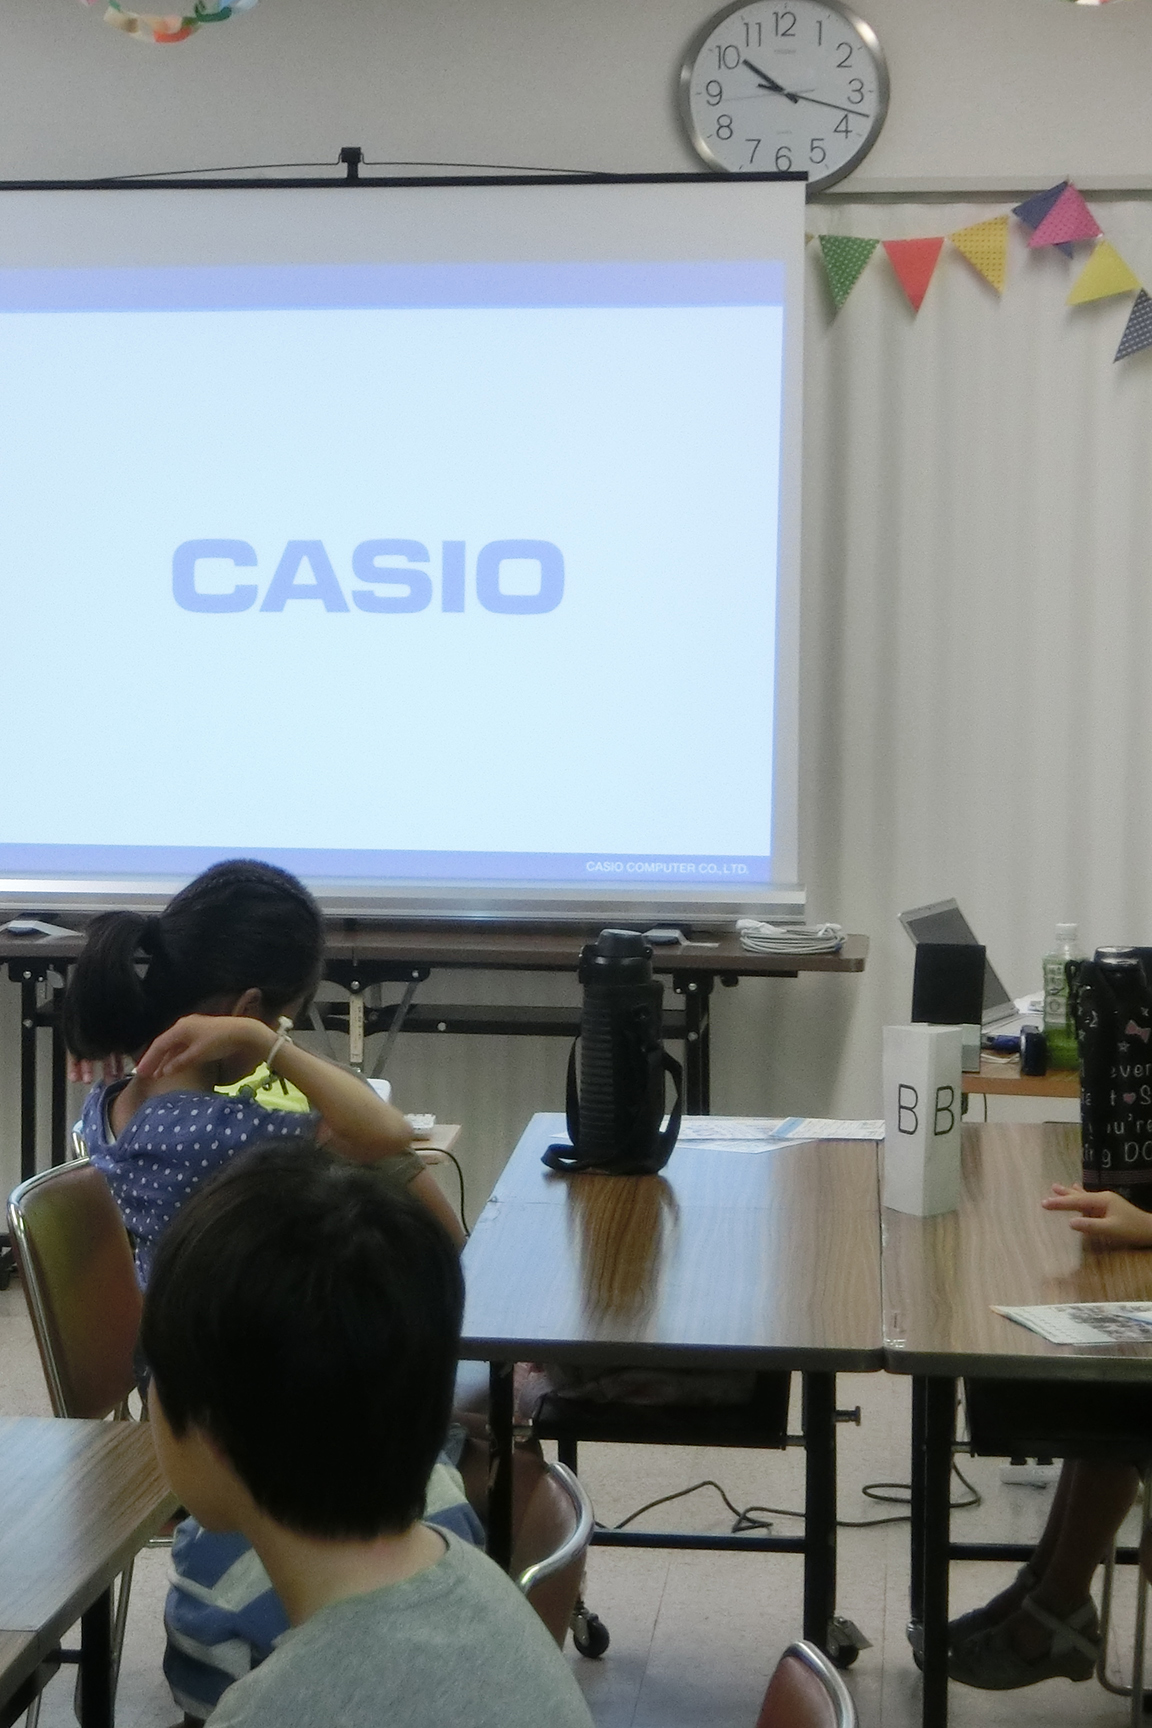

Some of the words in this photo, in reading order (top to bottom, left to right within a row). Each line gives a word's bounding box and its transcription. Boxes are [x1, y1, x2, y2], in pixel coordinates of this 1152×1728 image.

[743, 22, 762, 47] 11
[773, 11, 796, 37] 12
[816, 20, 823, 46] 1
[716, 45, 740, 69] 10
[836, 42, 853, 68] 2
[706, 80, 722, 106] 9
[847, 78, 864, 104] 3
[716, 114, 733, 140] 8
[833, 113, 853, 139] 4
[745, 139, 761, 164] 7
[775, 146, 792, 172] 6
[809, 138, 826, 164] 5
[172, 538, 565, 615] CASIO
[586, 861, 624, 872] CASIO
[626, 862, 695, 873] COMPUTER
[898, 1083, 919, 1135] B
[934, 1085, 955, 1136] B
